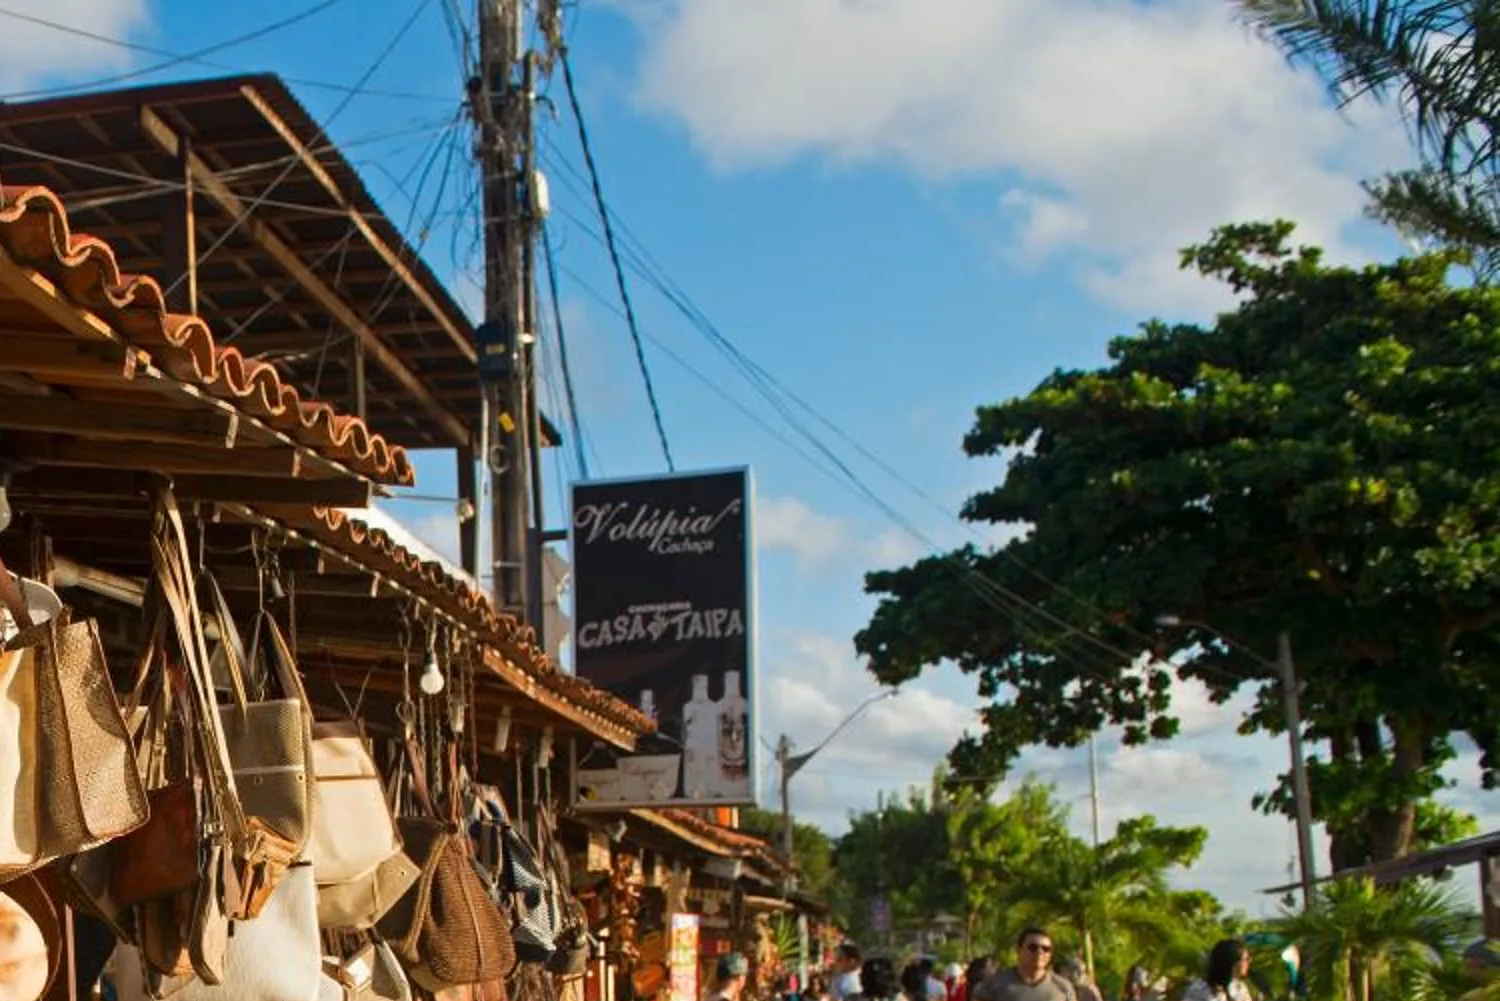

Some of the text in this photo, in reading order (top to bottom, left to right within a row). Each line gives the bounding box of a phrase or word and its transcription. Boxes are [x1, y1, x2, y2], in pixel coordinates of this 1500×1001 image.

[574, 498, 741, 552] Volúpia
[577, 607, 744, 649] CASA TAIPA
